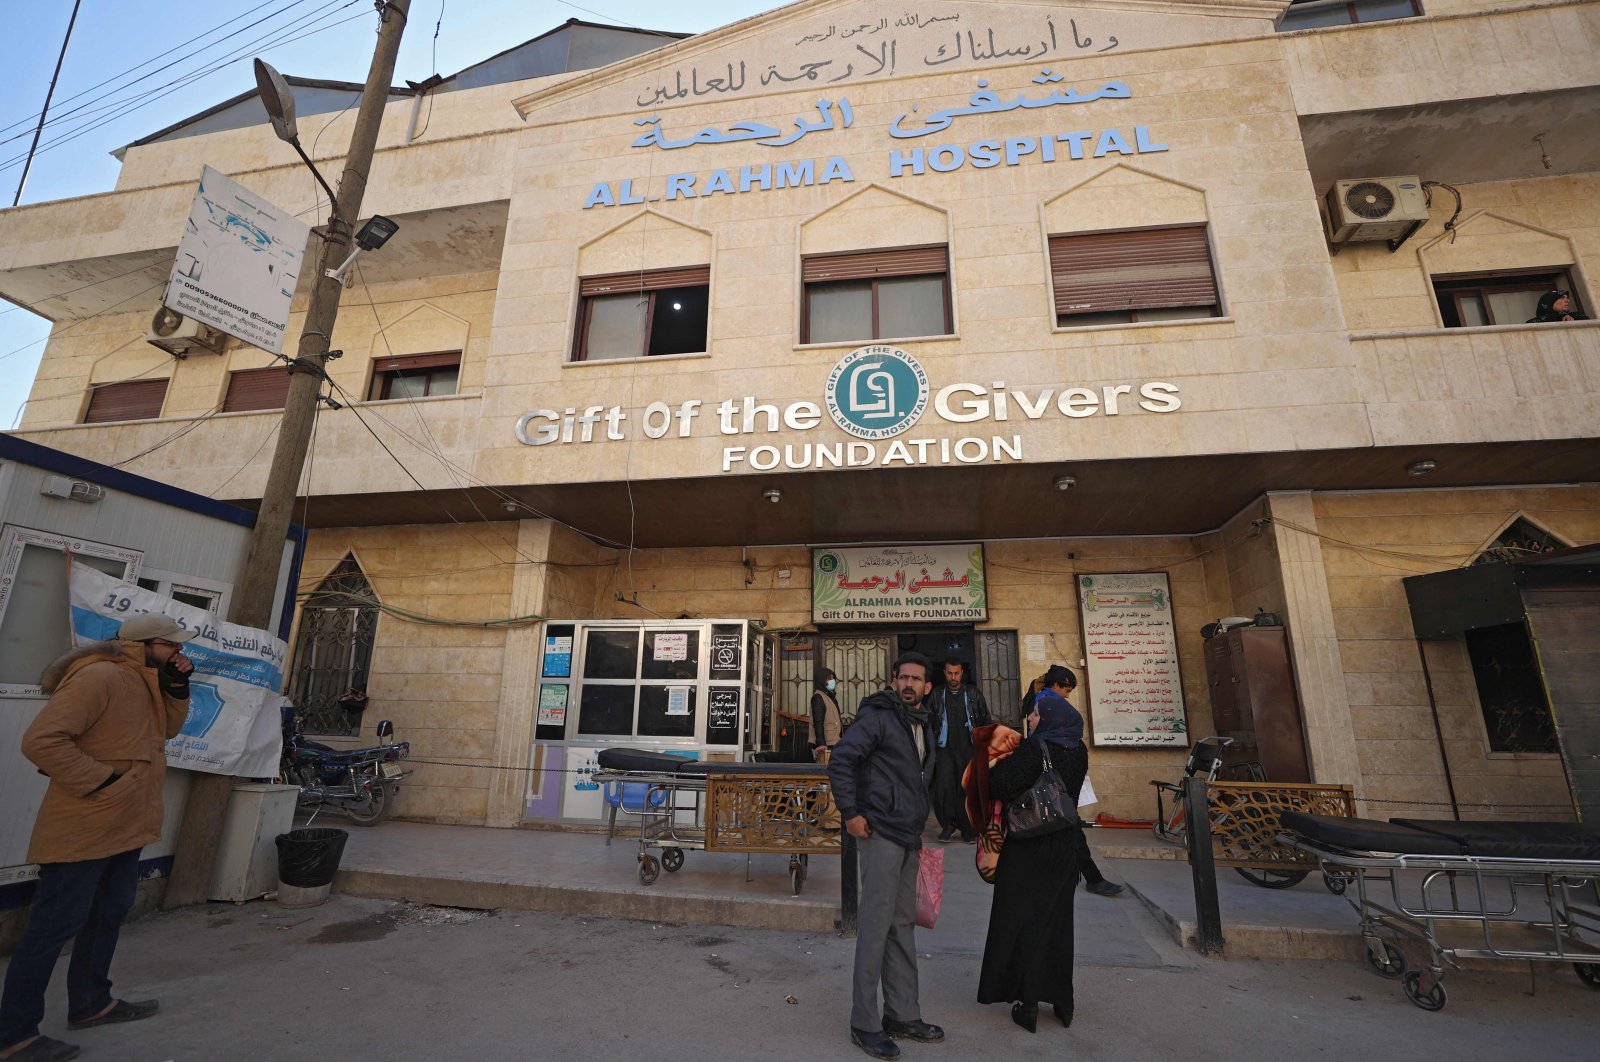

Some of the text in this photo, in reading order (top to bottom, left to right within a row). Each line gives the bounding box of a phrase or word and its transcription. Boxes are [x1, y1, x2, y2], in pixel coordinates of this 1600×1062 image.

[795, 25, 836, 46] الرحيم
[840, 18, 888, 41] الرحمن
[636, 60, 746, 107] للعالمين
[631, 95, 855, 150] الرحمة
[889, 124, 1169, 178] HOSPITAL
[844, 352, 860, 364] OF
[863, 346, 892, 355] THE
[514, 405, 627, 446] Gift
[716, 395, 822, 436] the
[933, 380, 1183, 424] Givers
[828, 402, 878, 438] AL-RAHMA
[721, 434, 1024, 472] FOUNDATION
[837, 569, 906, 594] الرحمة
[103, 593, 132, 613] 19
[822, 608, 982, 619] Gift Of The Givers FOUNDATION
[844, 595, 966, 607] ALRAHMA HOSPITAL
